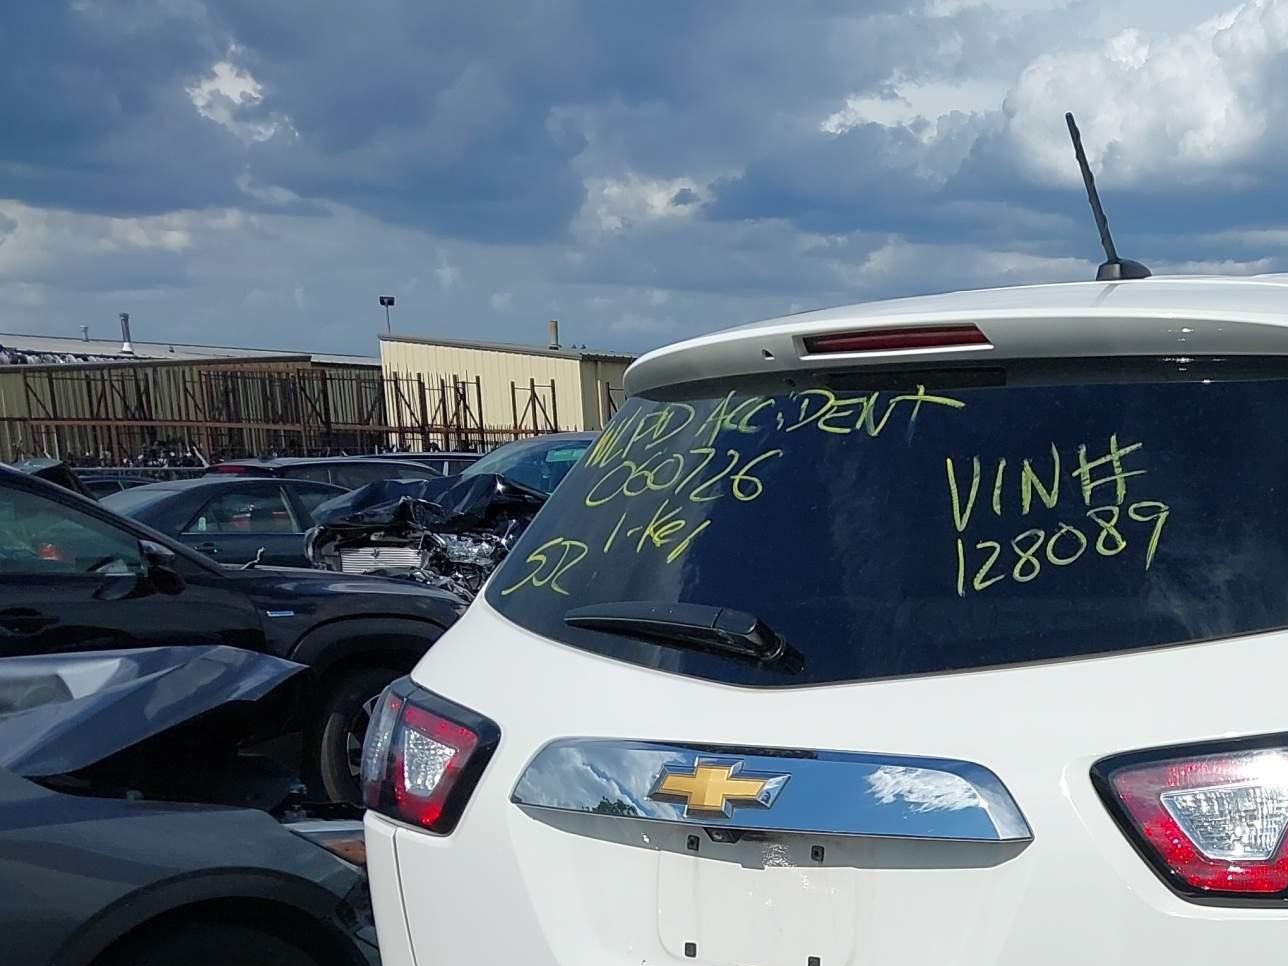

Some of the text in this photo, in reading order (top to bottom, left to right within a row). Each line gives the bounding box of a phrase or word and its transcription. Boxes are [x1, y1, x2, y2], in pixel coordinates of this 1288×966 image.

[585, 448, 783, 507] 060726
[946, 432, 1148, 532] VIN#
[956, 501, 1169, 598] 128089
